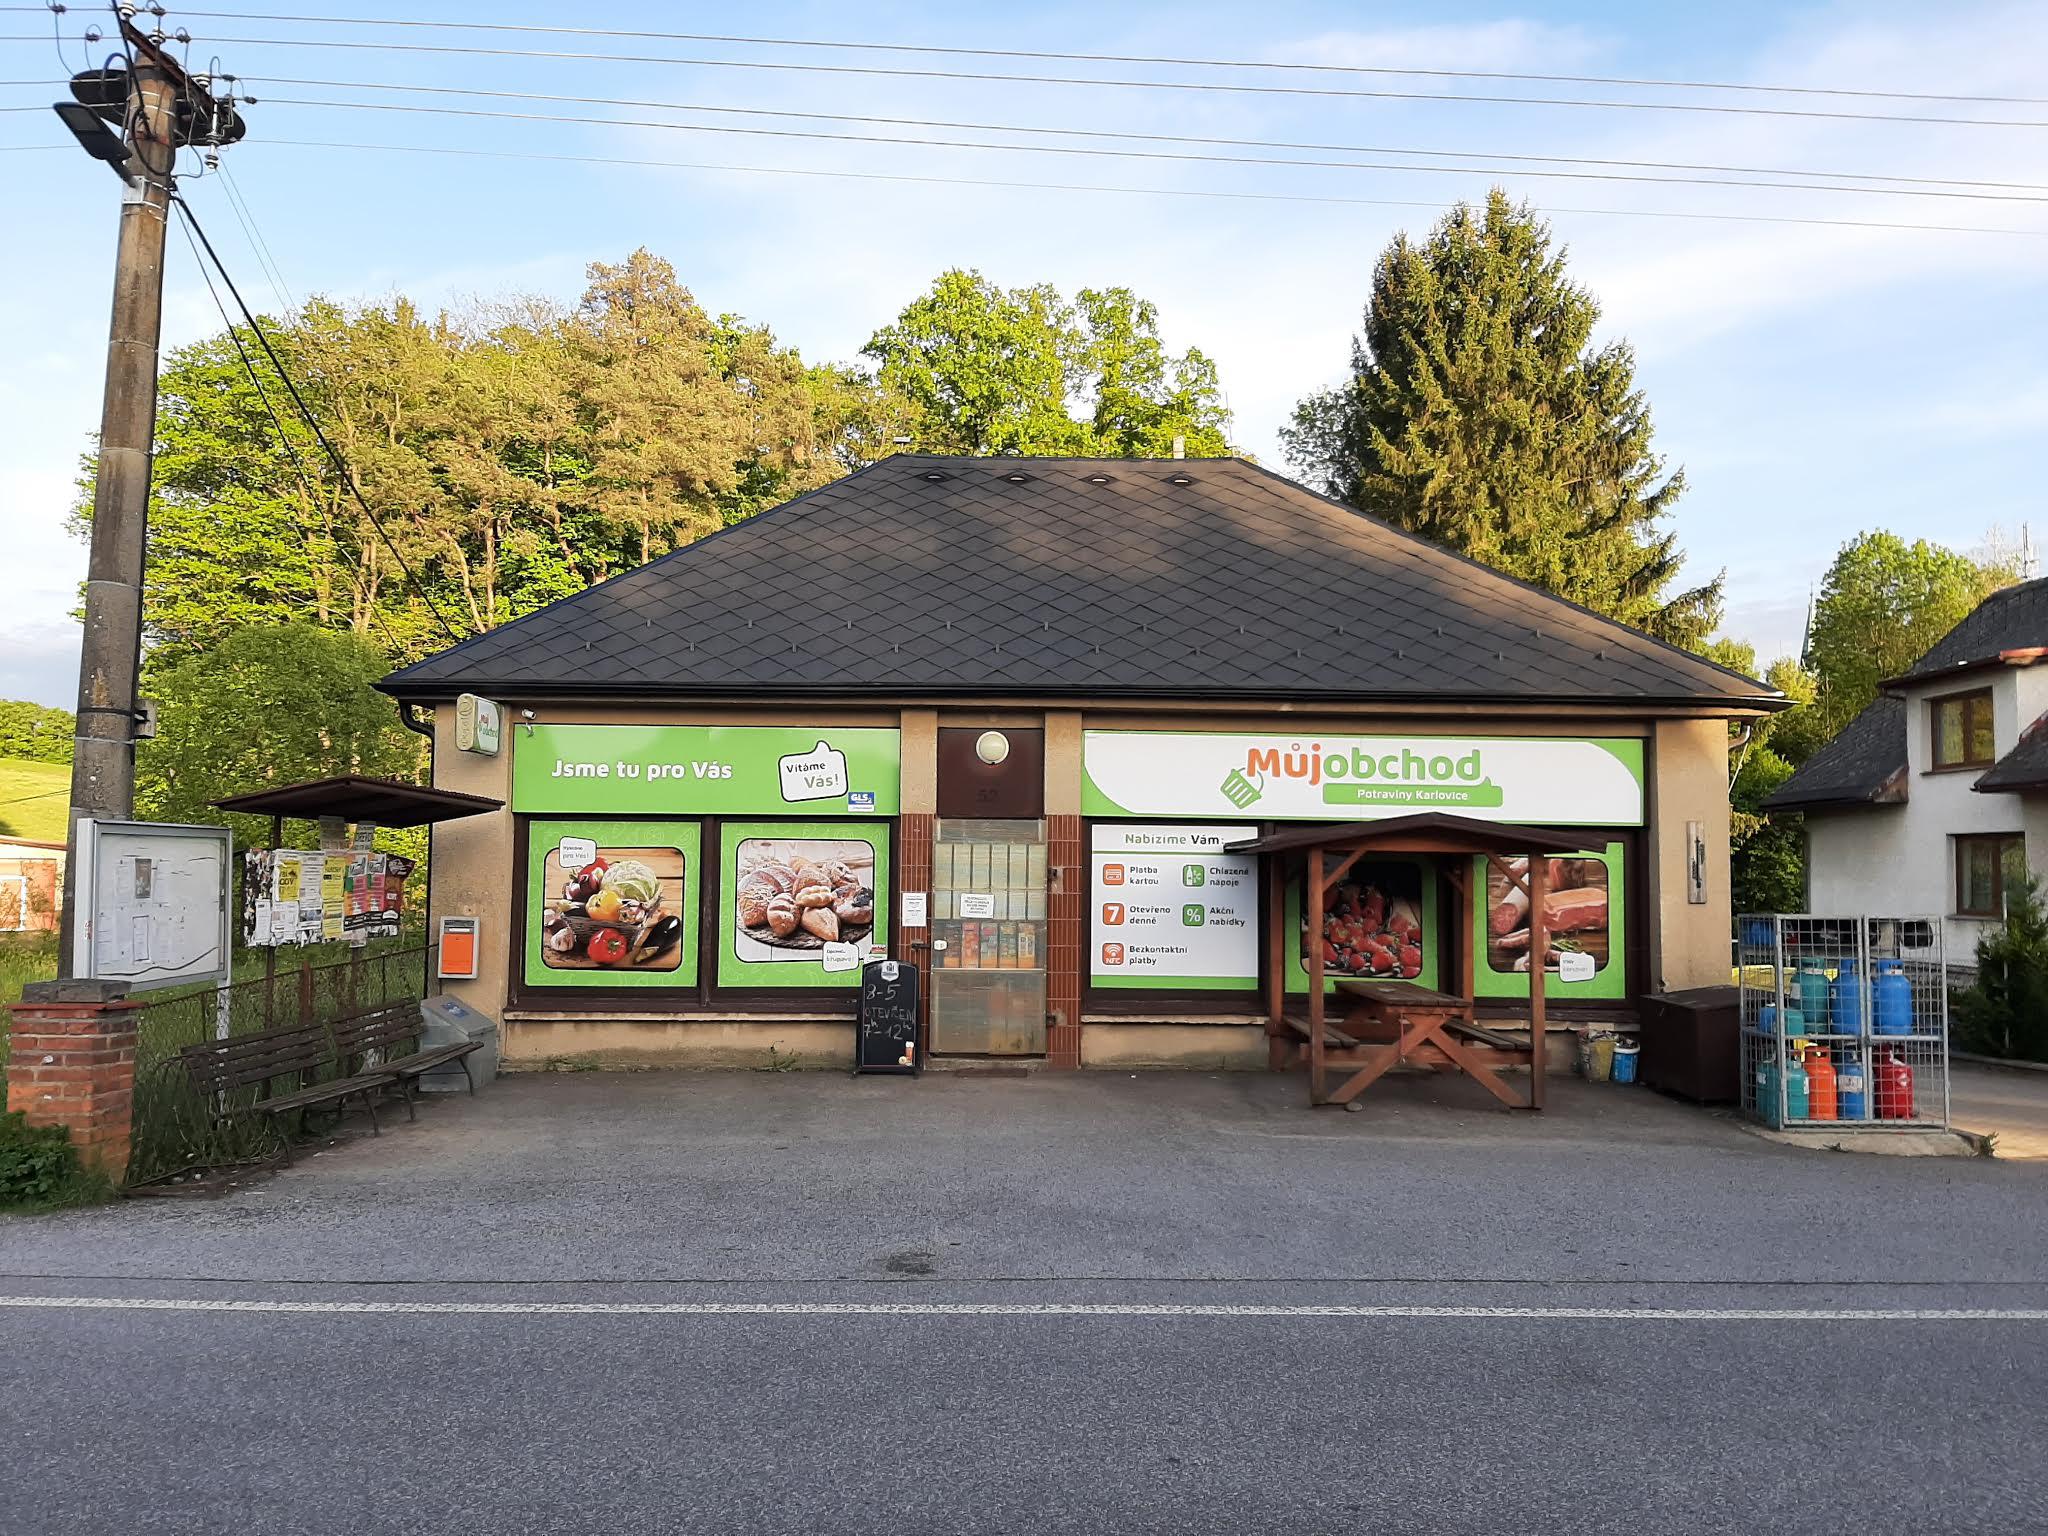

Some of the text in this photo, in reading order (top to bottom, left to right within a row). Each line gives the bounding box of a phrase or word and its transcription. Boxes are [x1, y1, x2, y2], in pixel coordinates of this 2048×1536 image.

[551, 760, 732, 782] Jsme tu pro Vás
[804, 773, 839, 788] Vás!
[1357, 789, 1468, 801] Potraviny Karlovice
[1129, 866, 1158, 874] Platba
[1209, 867, 1249, 876] Chlazené
[1129, 877, 1159, 885] kartou
[1129, 905, 1171, 914] Otevřeno
[1107, 906, 1120, 923] 7
[1129, 957, 1157, 966] platby
